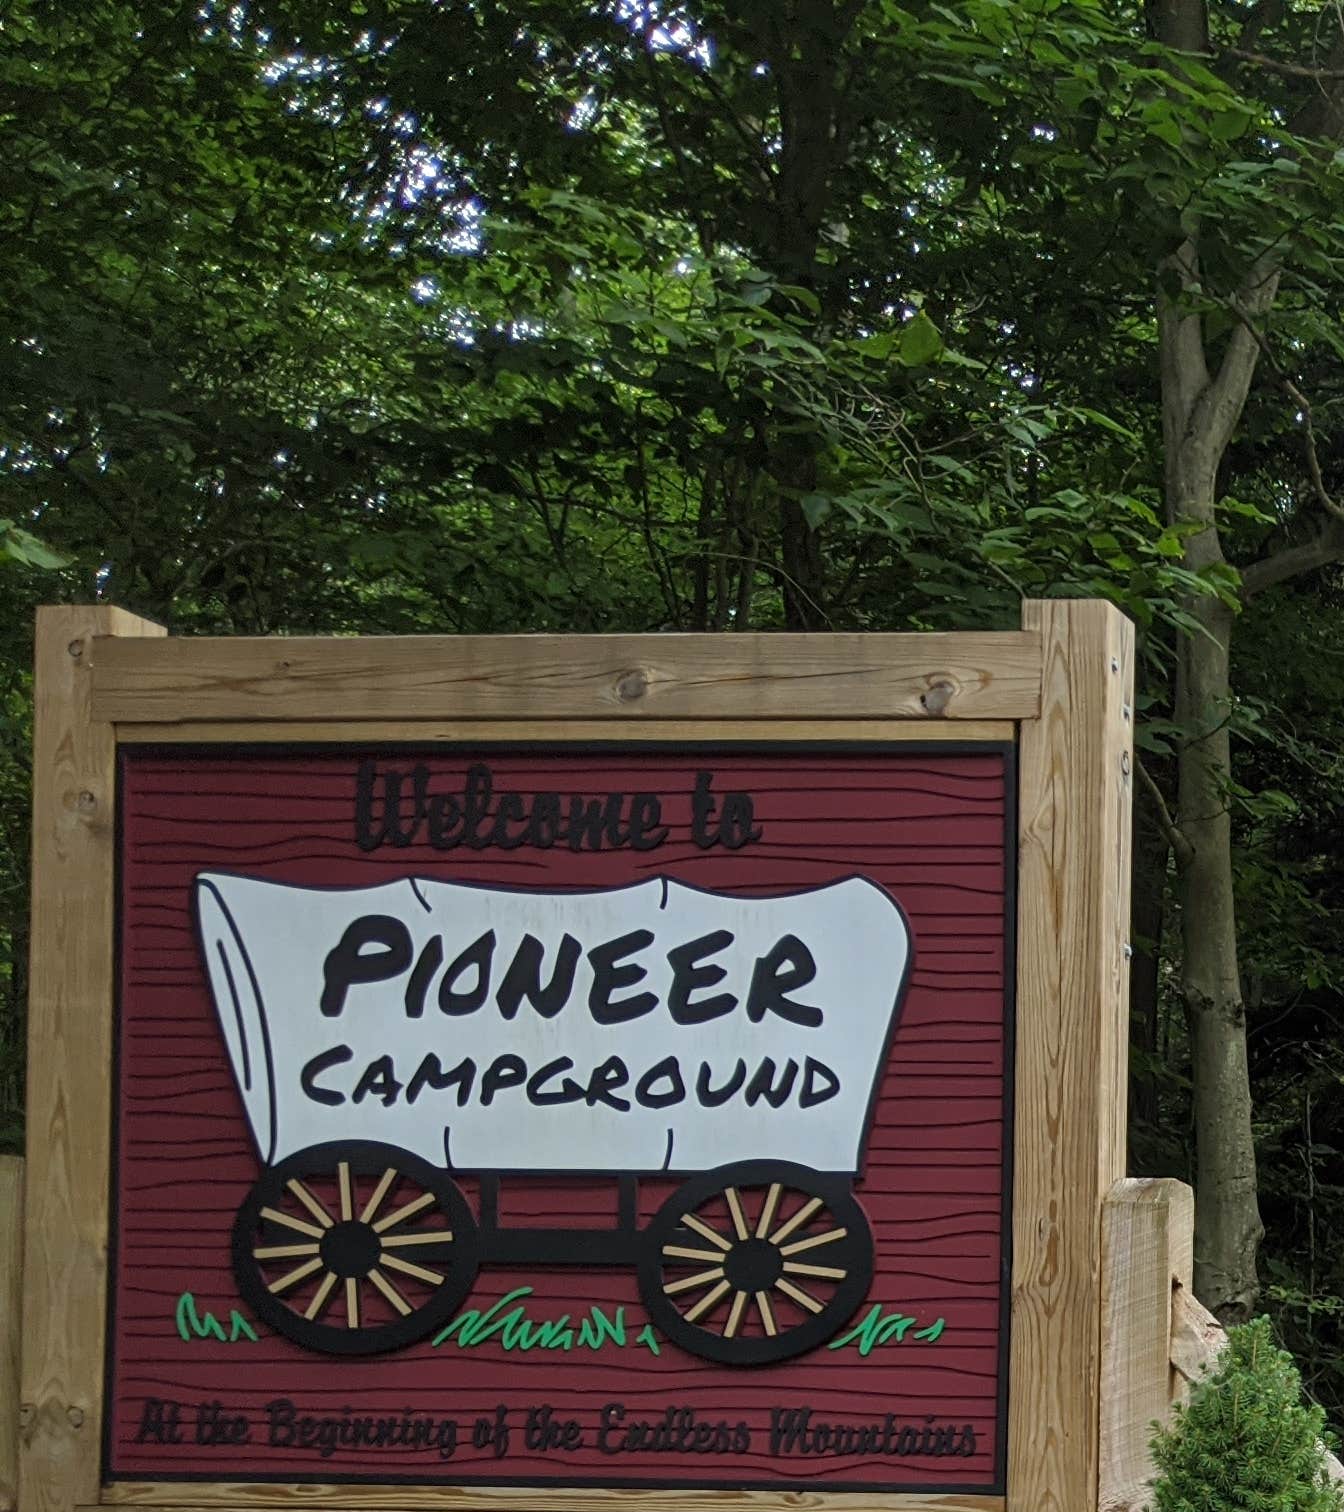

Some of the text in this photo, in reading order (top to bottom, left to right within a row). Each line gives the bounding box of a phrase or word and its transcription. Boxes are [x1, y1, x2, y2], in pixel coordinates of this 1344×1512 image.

[354, 762, 763, 852] Welcome to
[319, 914, 824, 1028] PIONEER
[300, 1044, 842, 1111] CAMPGROUND
[136, 1398, 977, 1459] At the Beginning of the Endless Mountains
